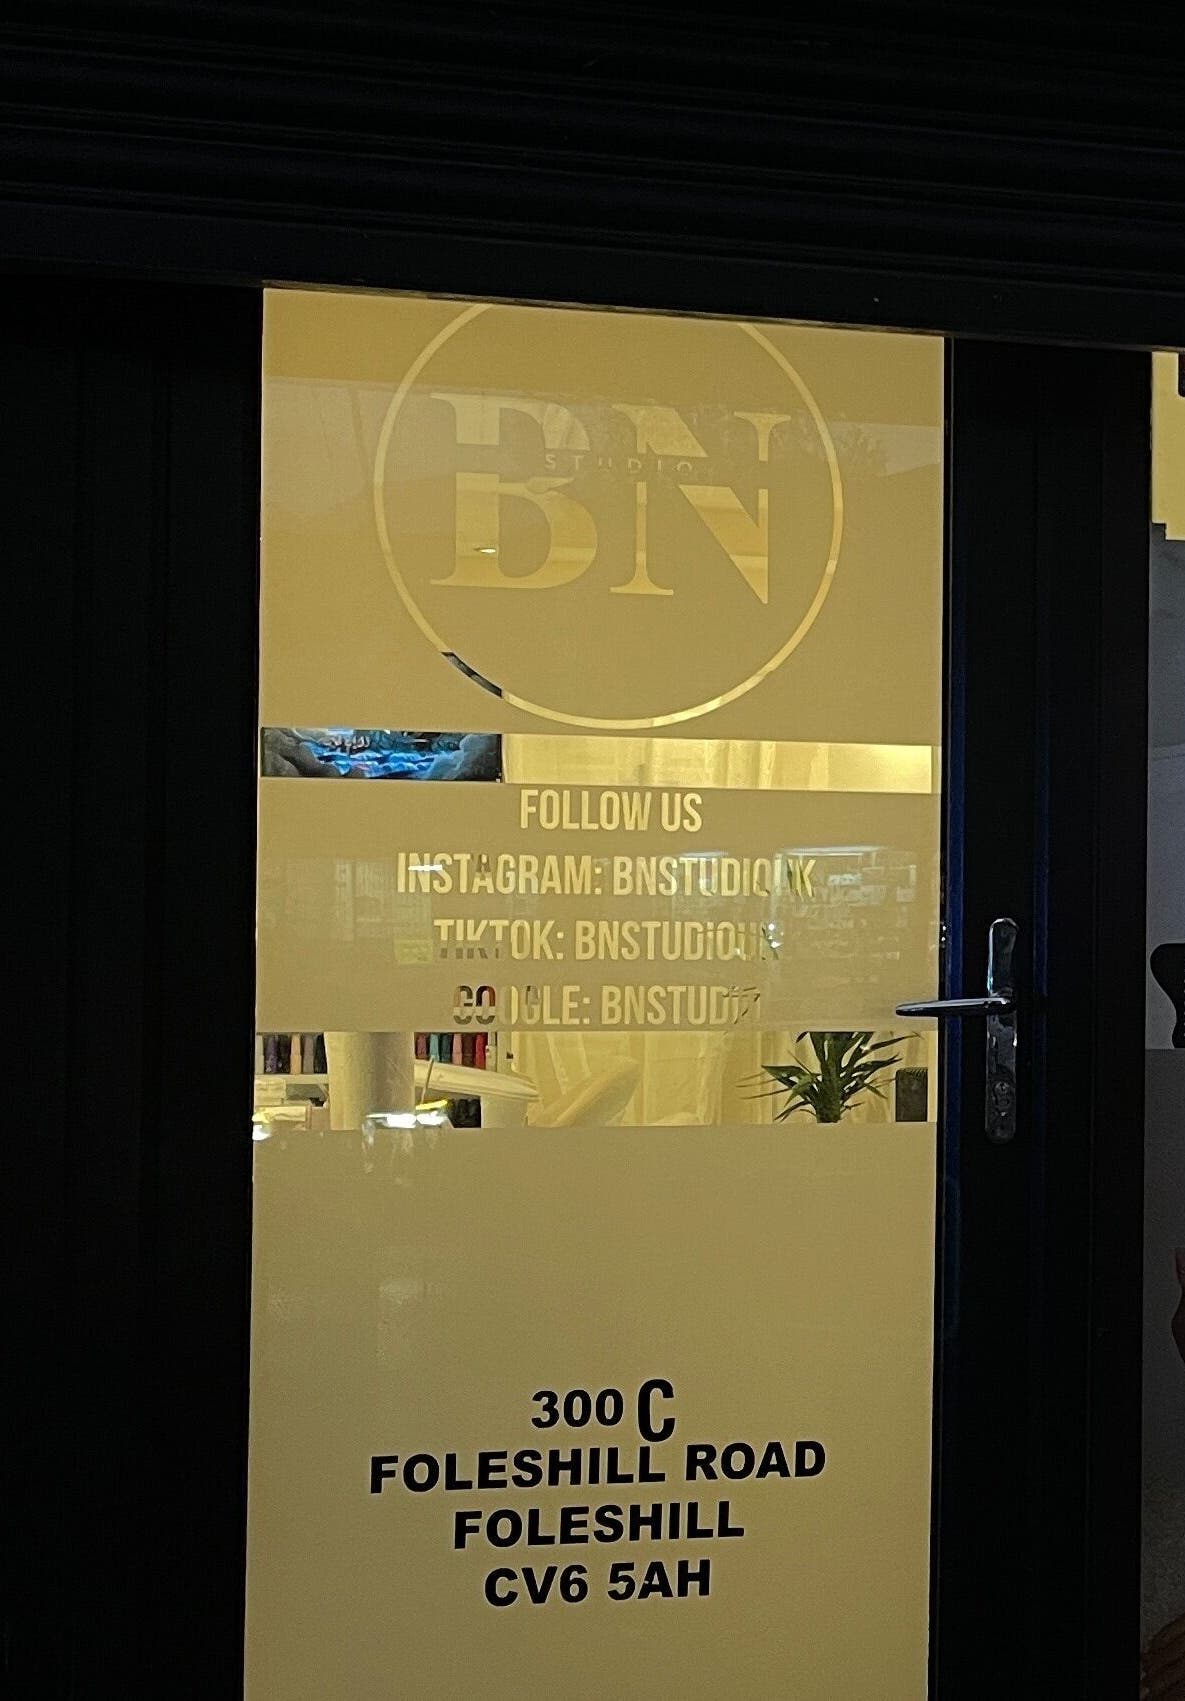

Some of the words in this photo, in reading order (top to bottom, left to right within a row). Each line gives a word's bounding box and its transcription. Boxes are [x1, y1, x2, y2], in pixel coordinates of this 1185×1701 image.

[430, 392, 791, 605] BN
[520, 789, 651, 832] FOLLOW
[661, 792, 703, 833] US
[397, 852, 602, 896] INSTAGRAM:
[434, 919, 564, 961] TIKTOK:
[452, 985, 590, 1026] GOOGLE:
[531, 1388, 624, 1429] 300
[637, 1378, 676, 1442] C
[370, 1445, 666, 1494] FOLESHILL
[685, 1441, 827, 1480] ROAD
[453, 1500, 745, 1549] FOLESHILL
[483, 1564, 588, 1607] CV6
[606, 1559, 711, 1601] 5AH
